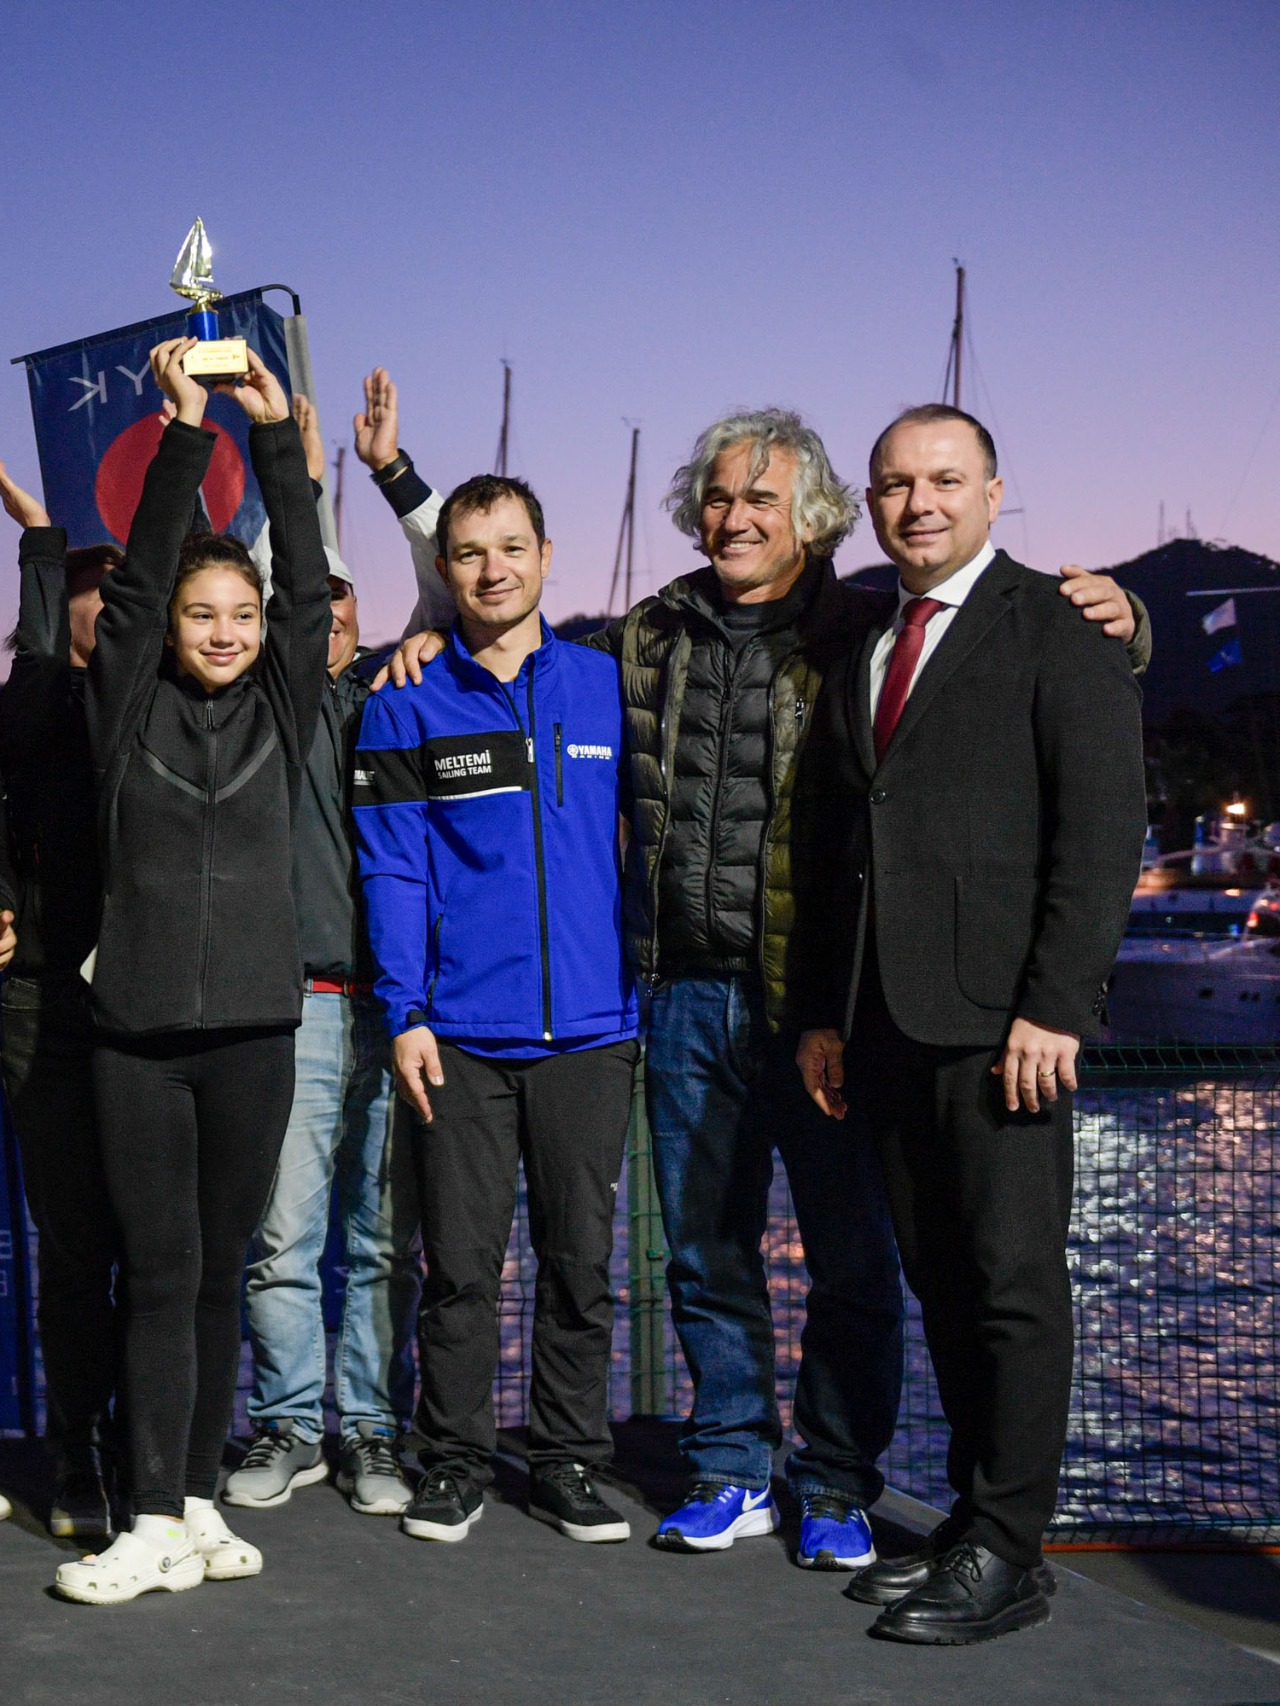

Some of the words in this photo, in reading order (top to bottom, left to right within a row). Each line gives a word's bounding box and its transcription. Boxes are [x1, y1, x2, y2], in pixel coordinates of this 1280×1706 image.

[578, 744, 612, 757] YAMAHA
[437, 768, 467, 780] SAILING
[467, 765, 492, 776] TEAM
